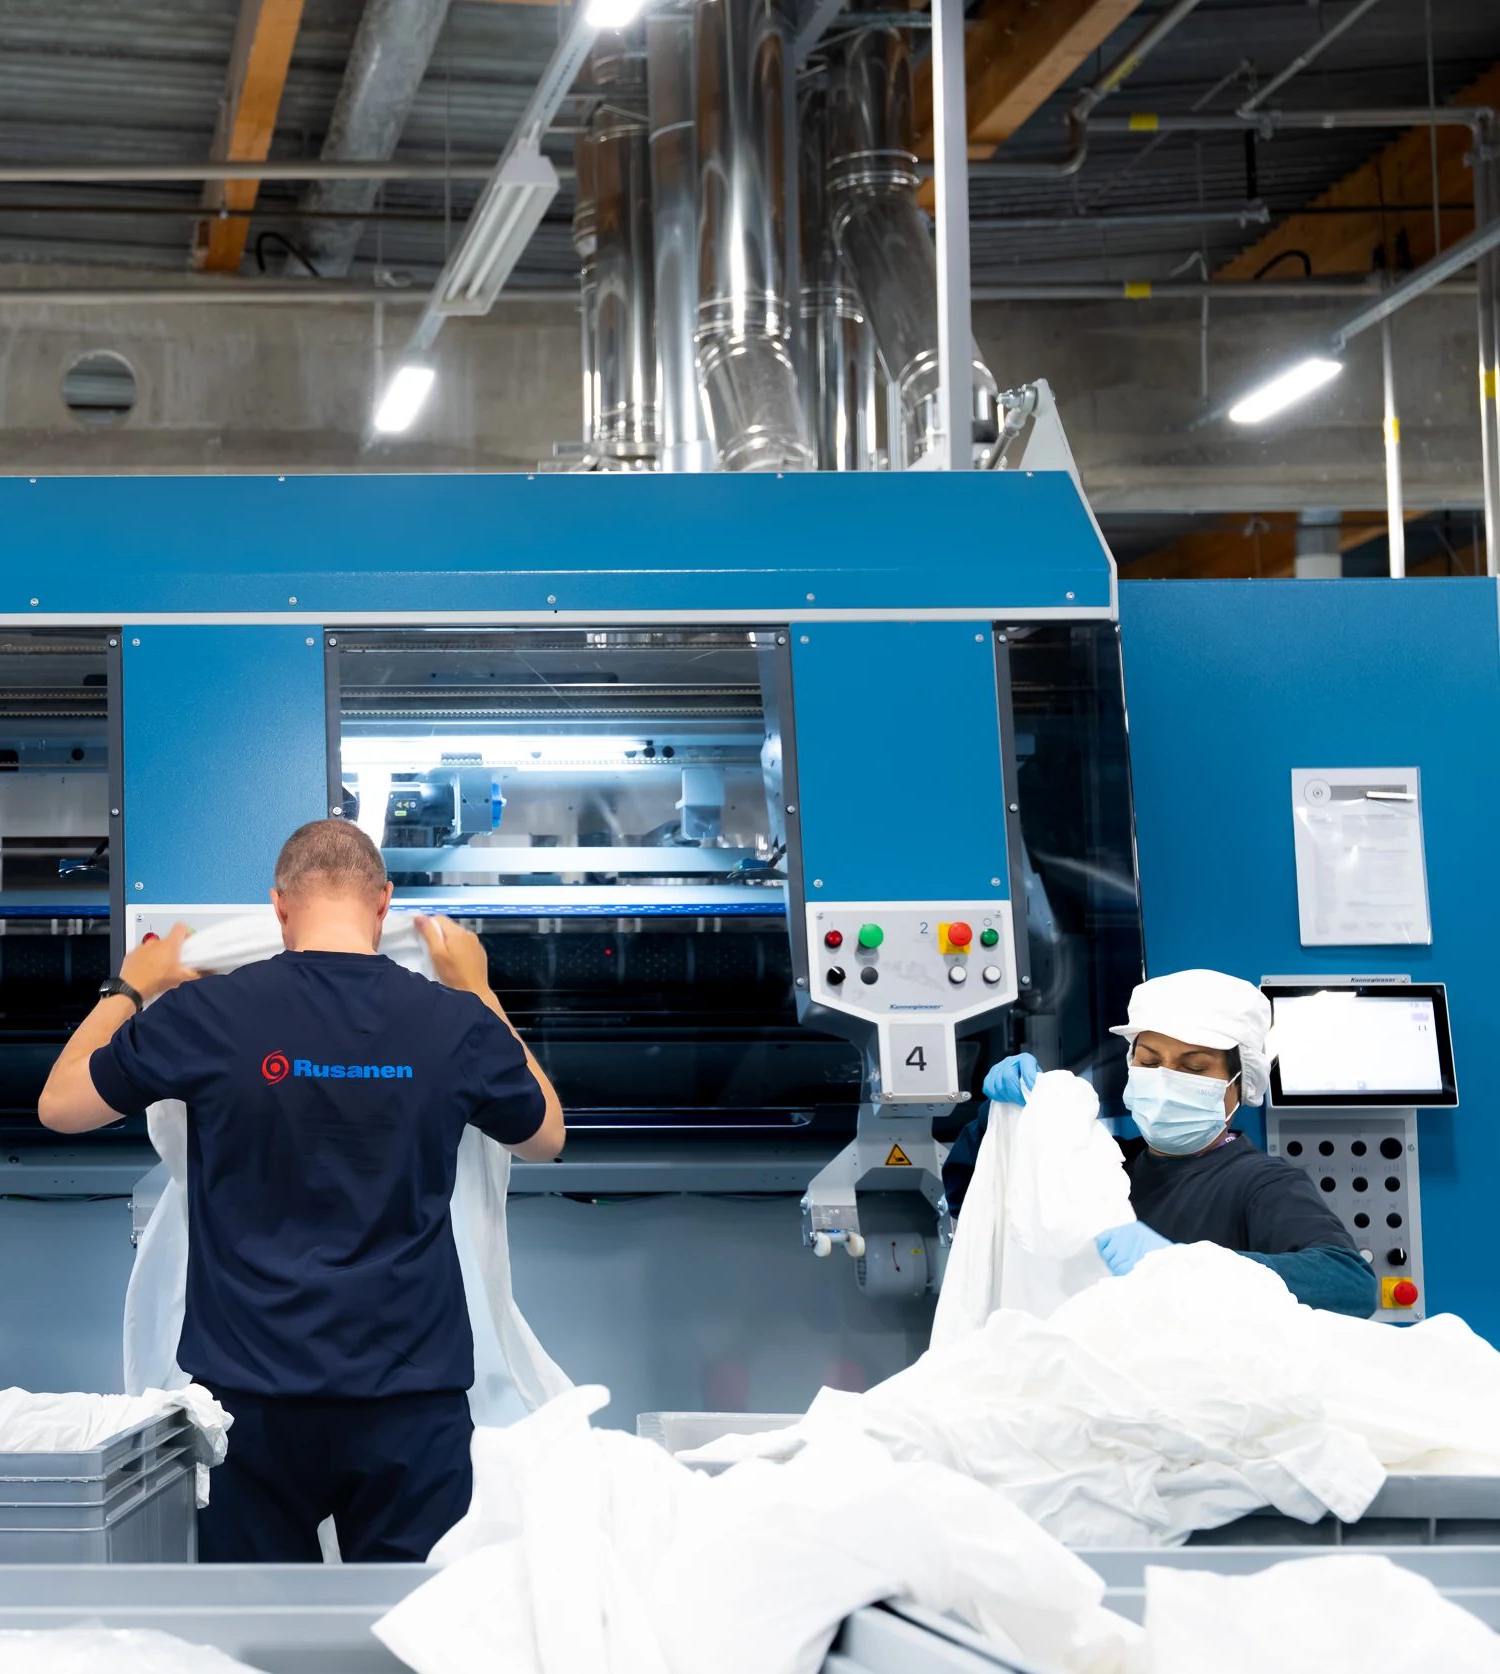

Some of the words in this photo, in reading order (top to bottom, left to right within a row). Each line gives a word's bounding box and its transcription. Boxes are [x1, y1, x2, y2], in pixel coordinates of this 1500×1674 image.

[920, 922, 928, 934] 2
[905, 1045, 928, 1072] 4
[293, 1059, 413, 1079] Rusanen
